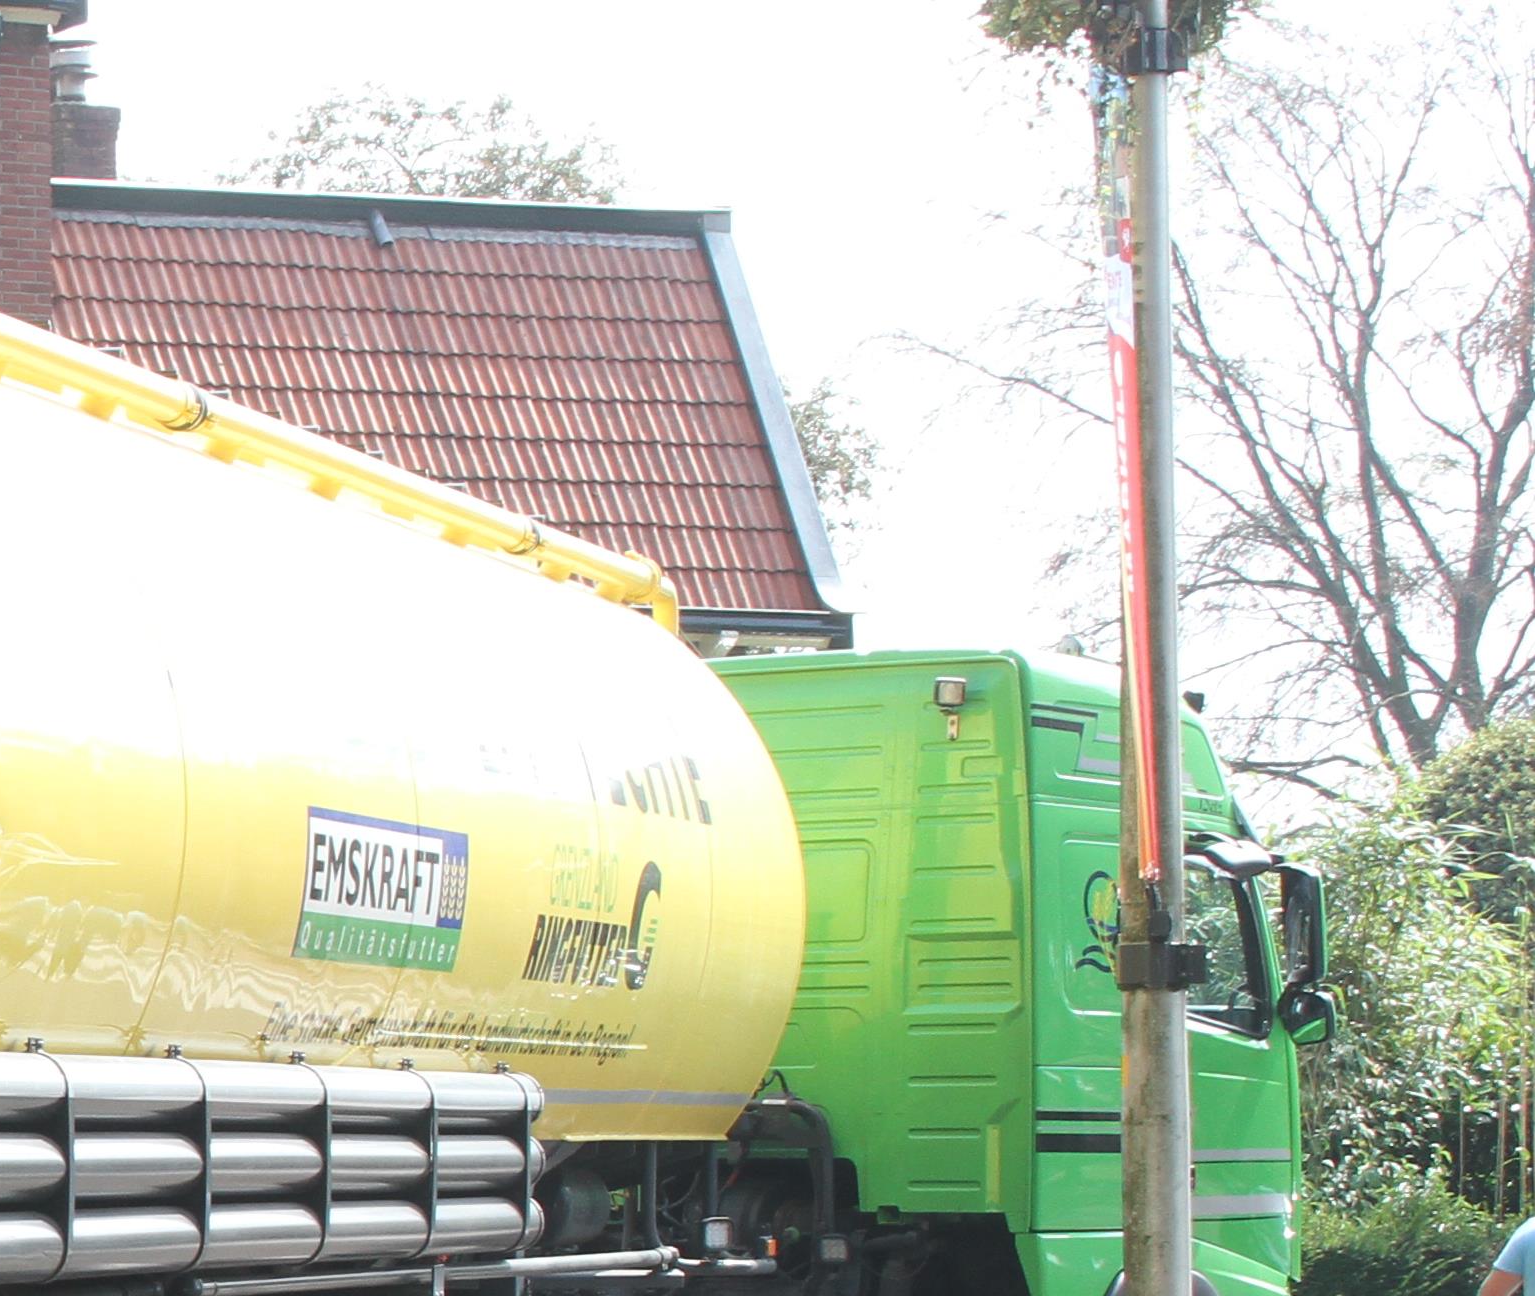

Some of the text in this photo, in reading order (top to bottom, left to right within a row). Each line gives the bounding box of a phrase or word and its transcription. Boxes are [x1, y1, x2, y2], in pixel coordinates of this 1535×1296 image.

[310, 833, 440, 915] EMSKRAFT
[300, 921, 456, 963] Qualitätsfutter
[522, 914, 627, 987] RINGFUTTER
